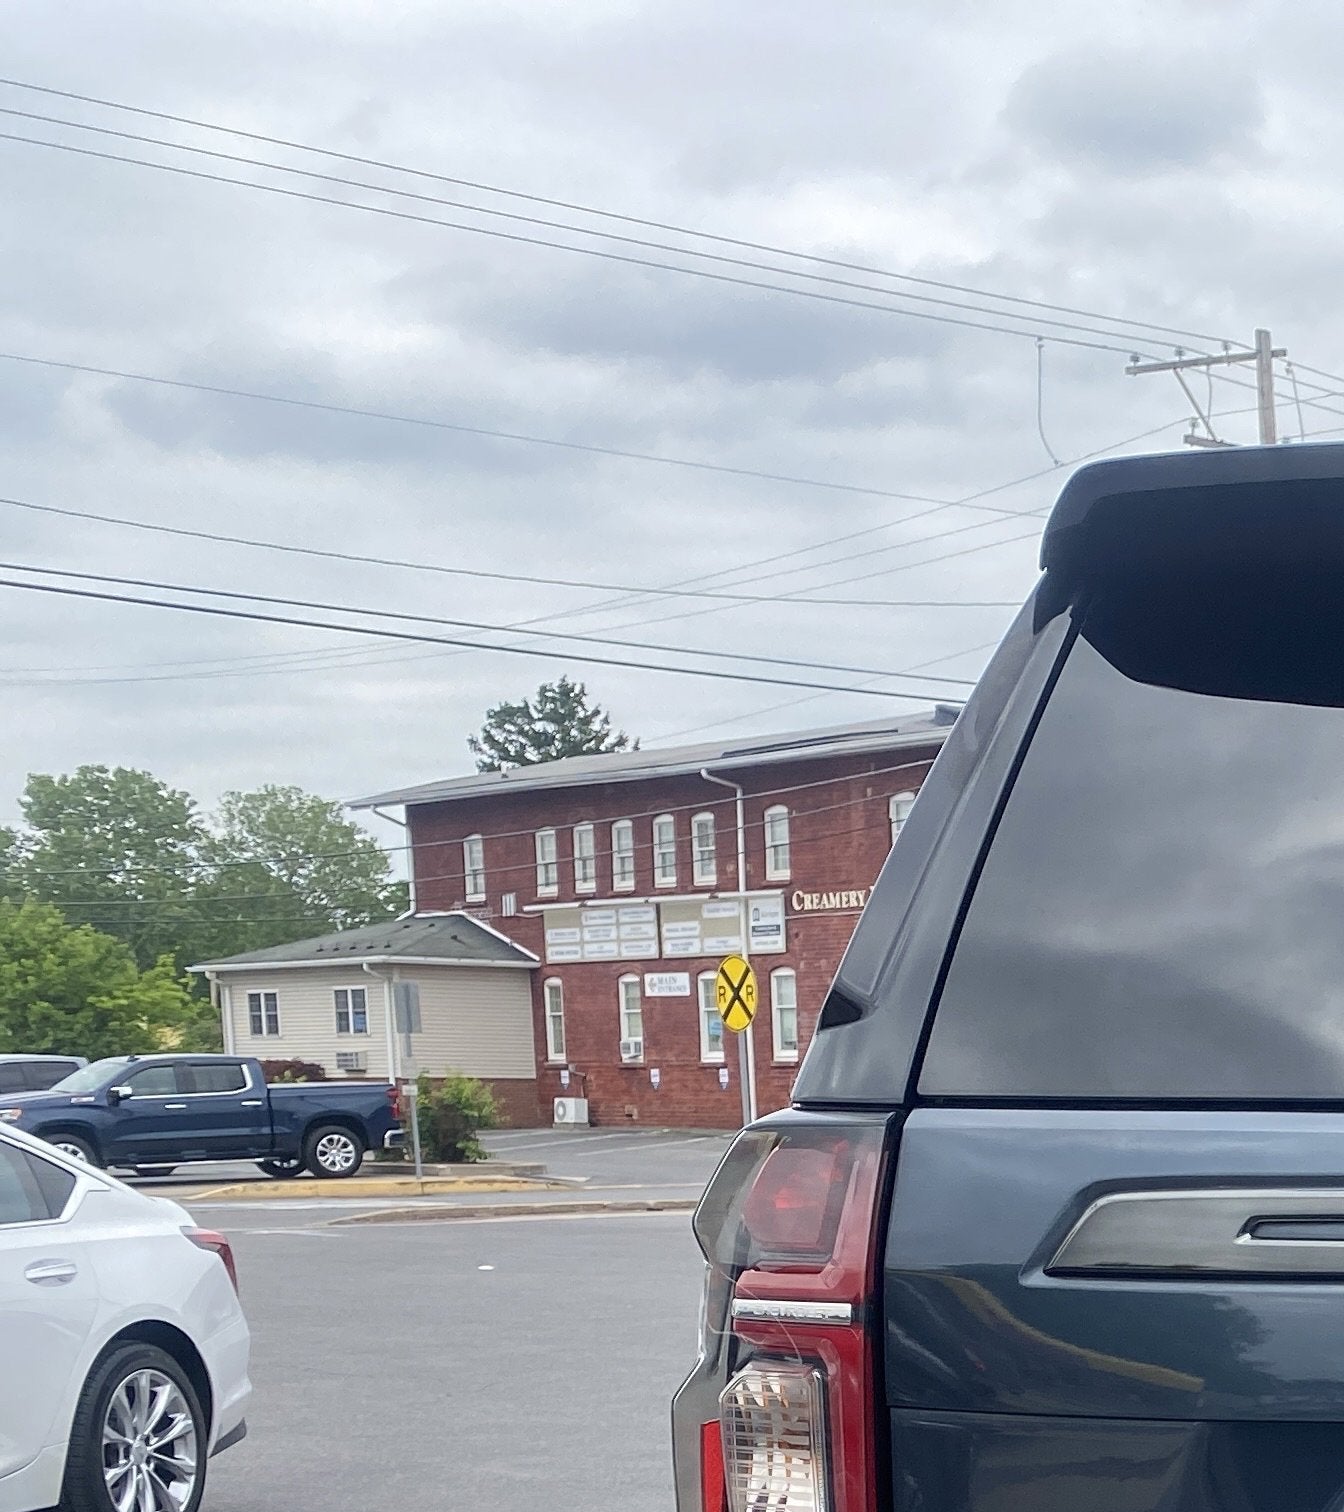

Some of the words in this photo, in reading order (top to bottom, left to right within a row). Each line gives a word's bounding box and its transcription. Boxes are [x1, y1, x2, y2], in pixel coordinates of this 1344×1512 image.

[791, 889, 867, 911] CREAMERY
[657, 975, 678, 985] MAIN
[718, 986, 727, 1003] R
[746, 984, 754, 1002] R
